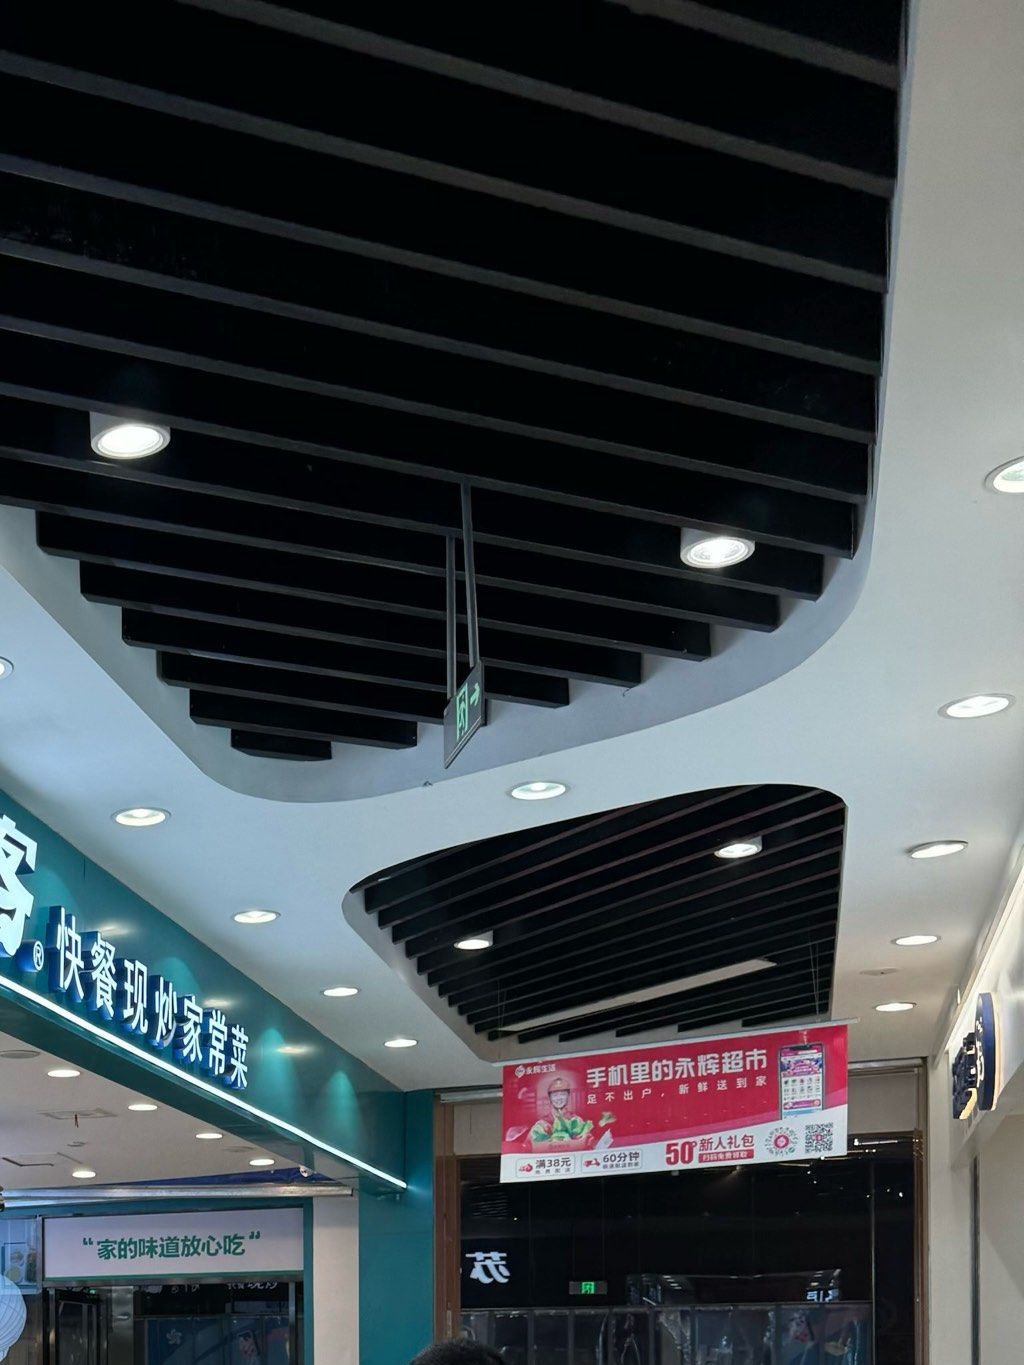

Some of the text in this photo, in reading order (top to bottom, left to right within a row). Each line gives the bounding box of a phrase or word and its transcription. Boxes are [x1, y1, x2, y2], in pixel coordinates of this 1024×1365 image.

[55, 906, 250, 1088] 快餐现炒家常菜
[586, 1048, 767, 1088] 手机里的永辉超市
[698, 1134, 755, 1151] 新人礼包
[535, 1157, 572, 1169] 满38元
[603, 1152, 640, 1163] 60分钟
